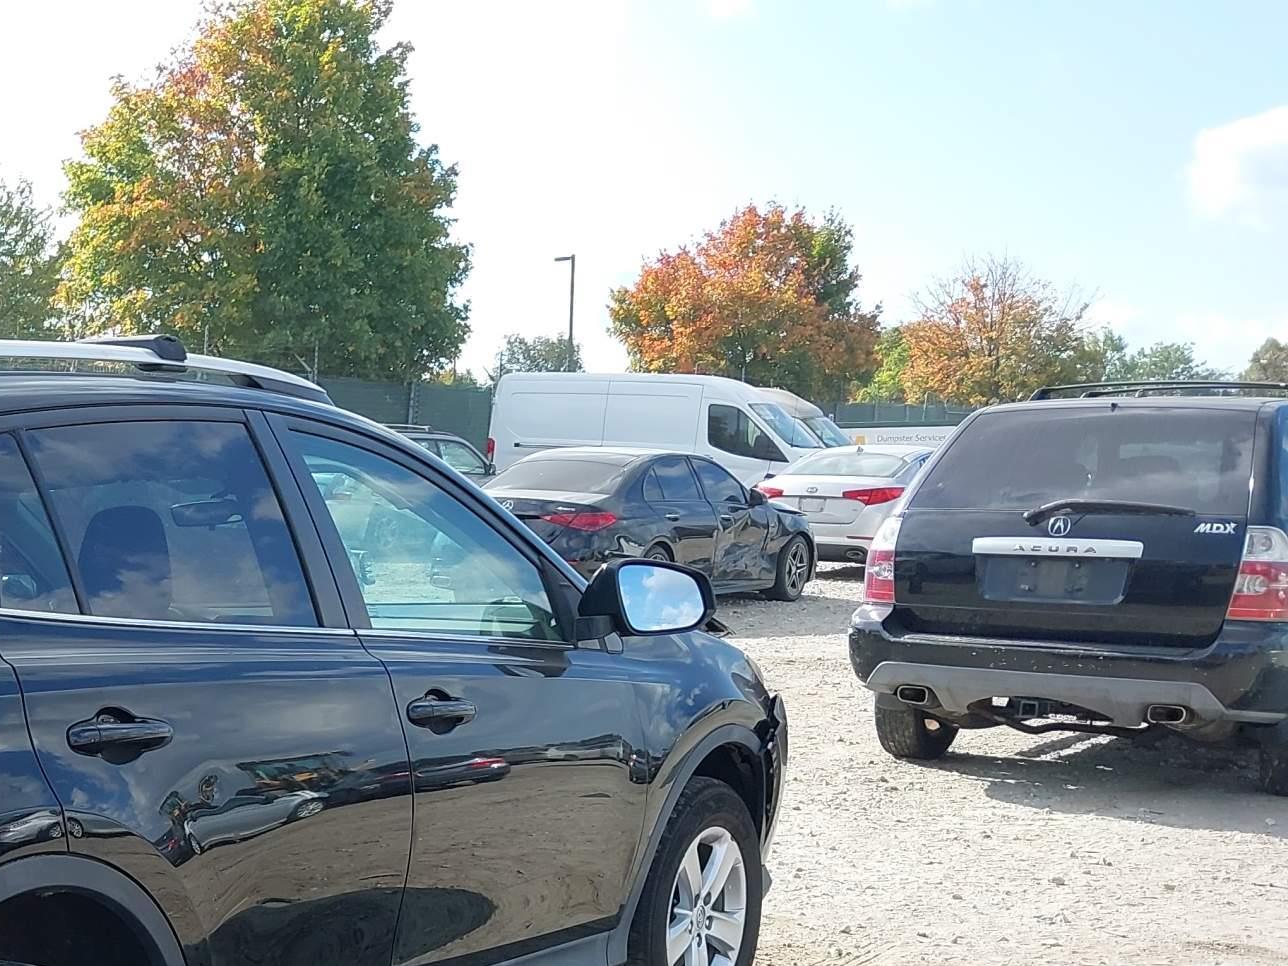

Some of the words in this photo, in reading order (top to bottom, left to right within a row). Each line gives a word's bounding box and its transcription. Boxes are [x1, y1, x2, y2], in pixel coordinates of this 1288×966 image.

[876, 433, 914, 443] Dumpster
[1193, 521, 1238, 535] MDX
[1013, 545, 1097, 554] ACURA
